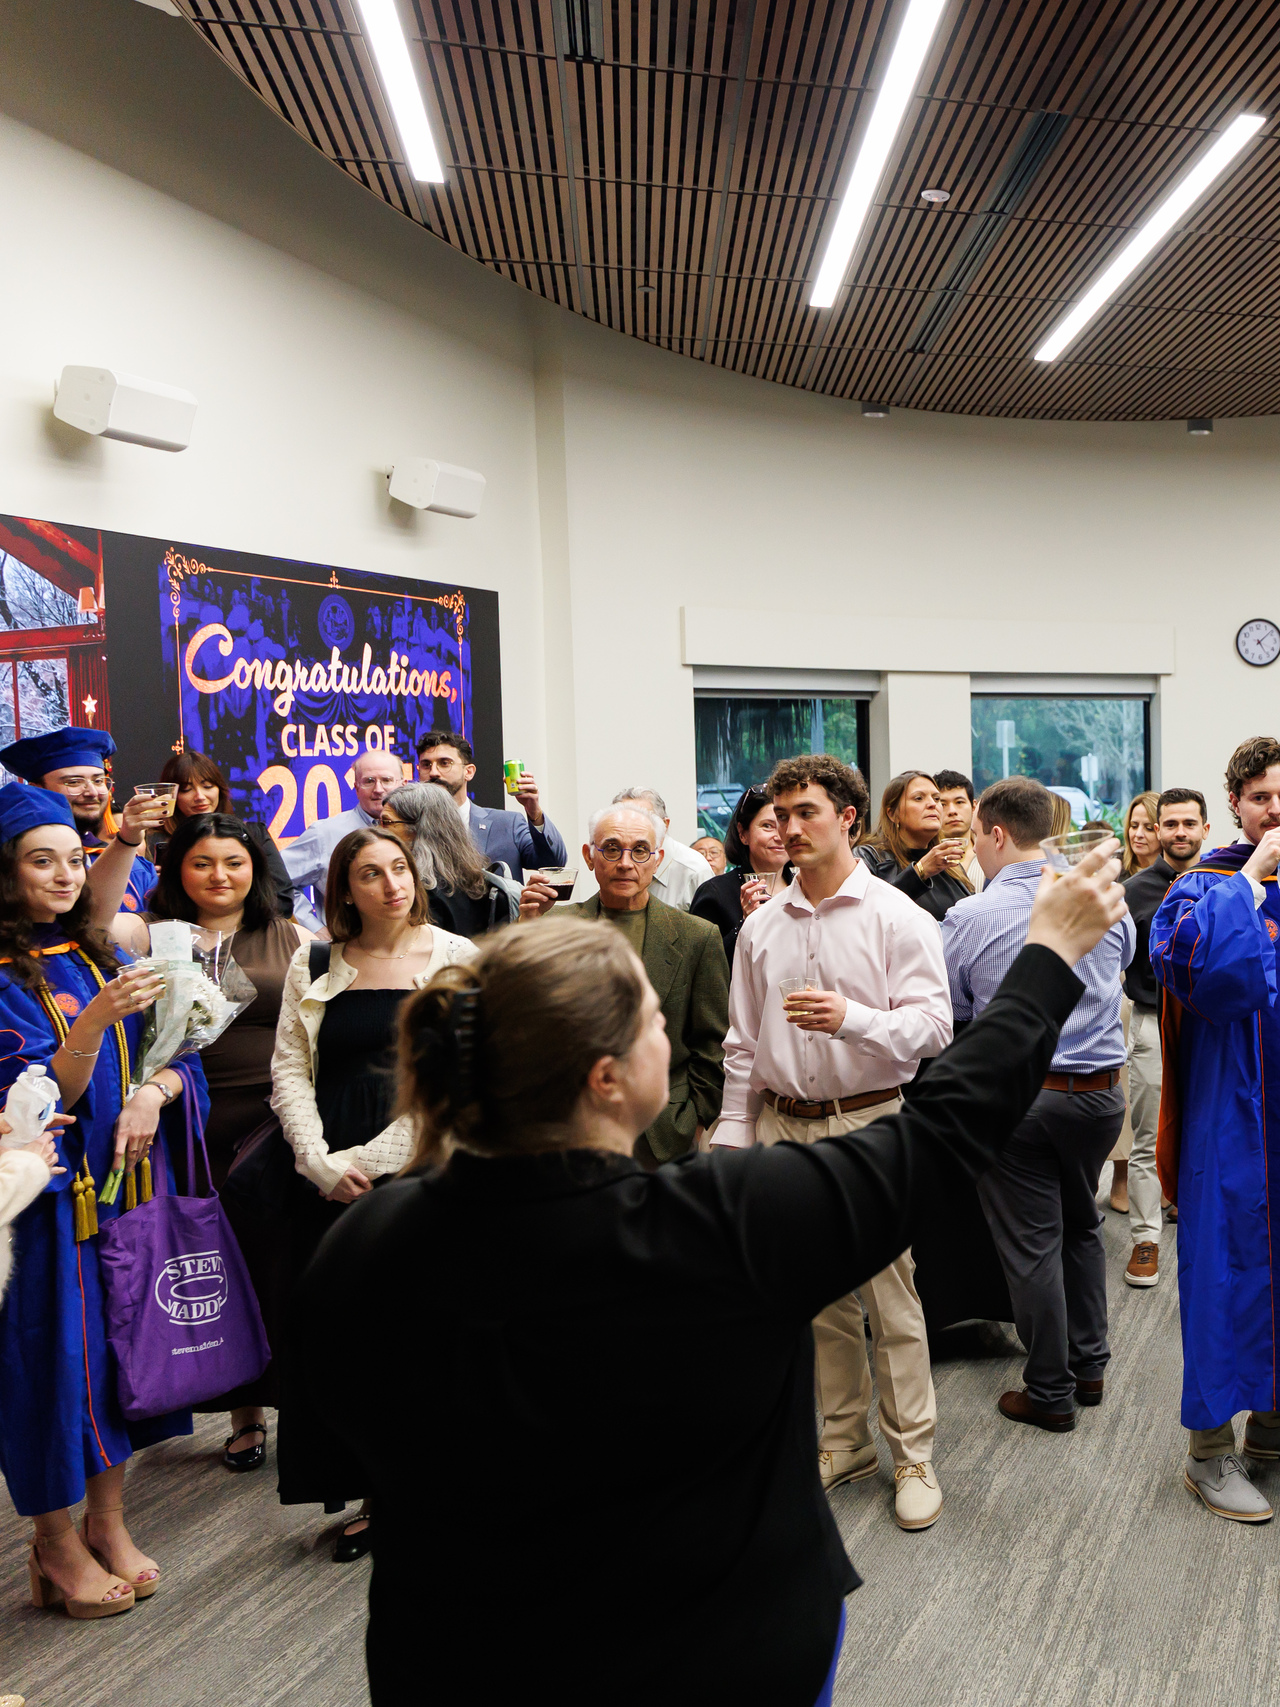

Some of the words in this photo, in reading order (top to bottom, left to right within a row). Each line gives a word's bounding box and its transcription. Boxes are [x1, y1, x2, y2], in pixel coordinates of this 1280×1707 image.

[184, 622, 458, 717] Congratulations,
[281, 723, 359, 758] CLASS
[365, 724, 395, 755] OF
[257, 763, 413, 851] 20
[166, 1256, 221, 1281] STEV
